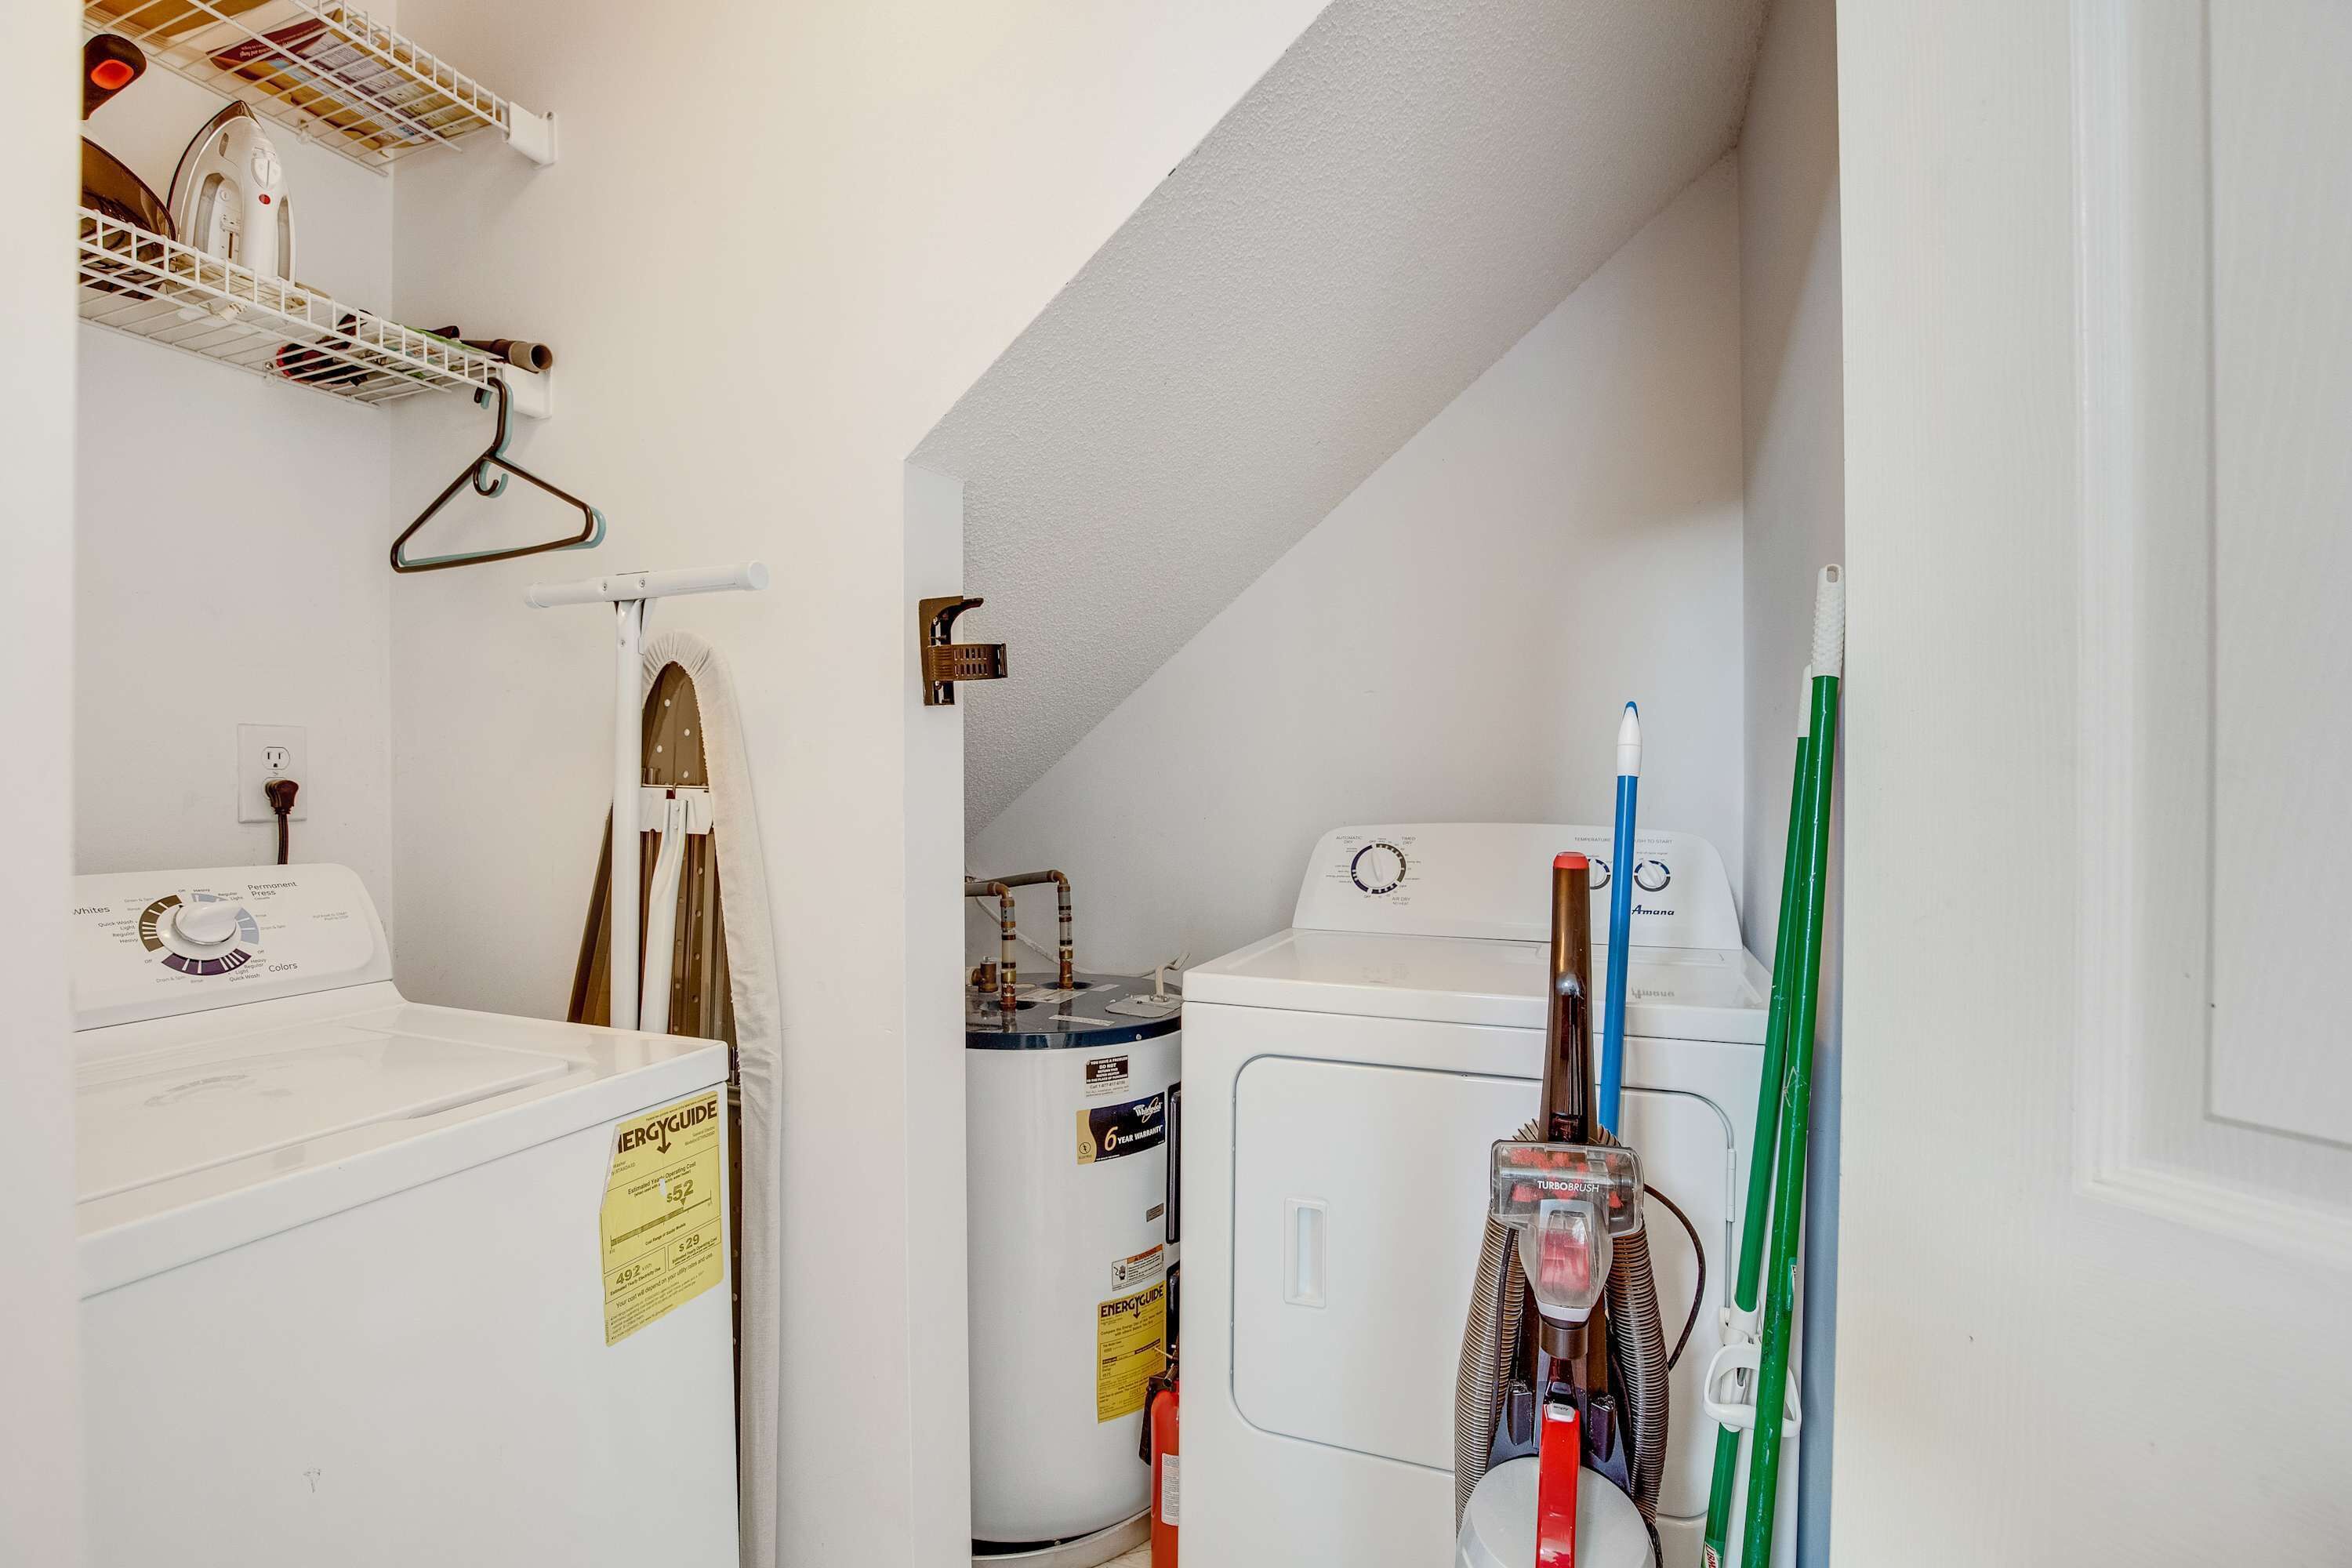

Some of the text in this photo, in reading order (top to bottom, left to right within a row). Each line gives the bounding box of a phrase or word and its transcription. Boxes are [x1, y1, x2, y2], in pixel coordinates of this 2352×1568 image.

[247, 881, 299, 891] Permanent
[1632, 904, 1675, 916] Amana
[268, 962, 298, 973] Colors
[1133, 1097, 1163, 1123] Whirlpool
[1105, 1125, 1163, 1151] 6 YEAR WARRANTY
[628, 1181, 650, 1195] Estimated
[665, 1166, 686, 1179] Operating
[666, 1179, 694, 1203] $52
[1537, 1180, 1599, 1192] TURBOBRUSH
[616, 1265, 641, 1284] 492
[611, 1284, 626, 1296] Estimated
[615, 1299, 626, 1308] Your
[627, 1294, 637, 1302] cost
[644, 1281, 661, 1294] depend
[667, 1272, 677, 1283] your
[677, 1266, 688, 1276] utility
[1101, 1285, 1163, 1318] ENERGYGUIDE
